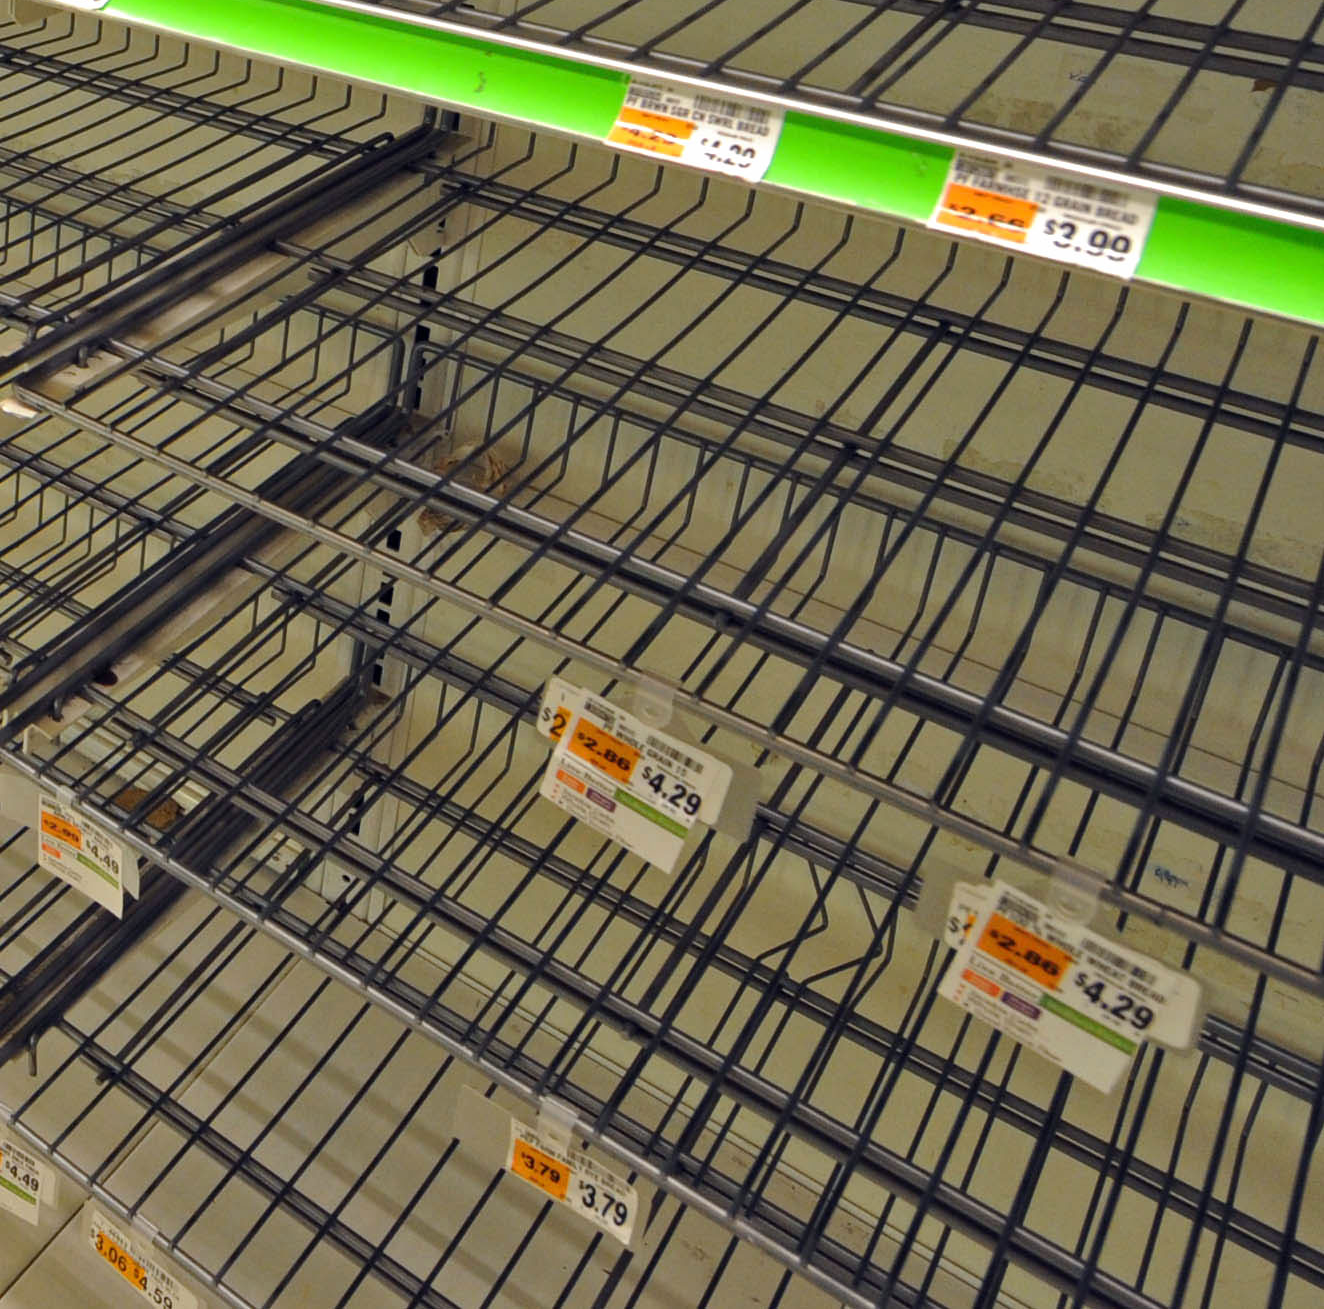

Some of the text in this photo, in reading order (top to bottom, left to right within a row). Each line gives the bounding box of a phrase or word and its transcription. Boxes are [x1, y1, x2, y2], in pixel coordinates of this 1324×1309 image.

[540, 706, 568, 738] $2
[641, 765, 702, 816] $4.29
[1074, 970, 1155, 1031] $4.29
[4, 1160, 40, 1192] $4.49
[520, 1151, 629, 1227] $3.79 $3.79
[89, 1227, 173, 1309] $3.06 $4.59
